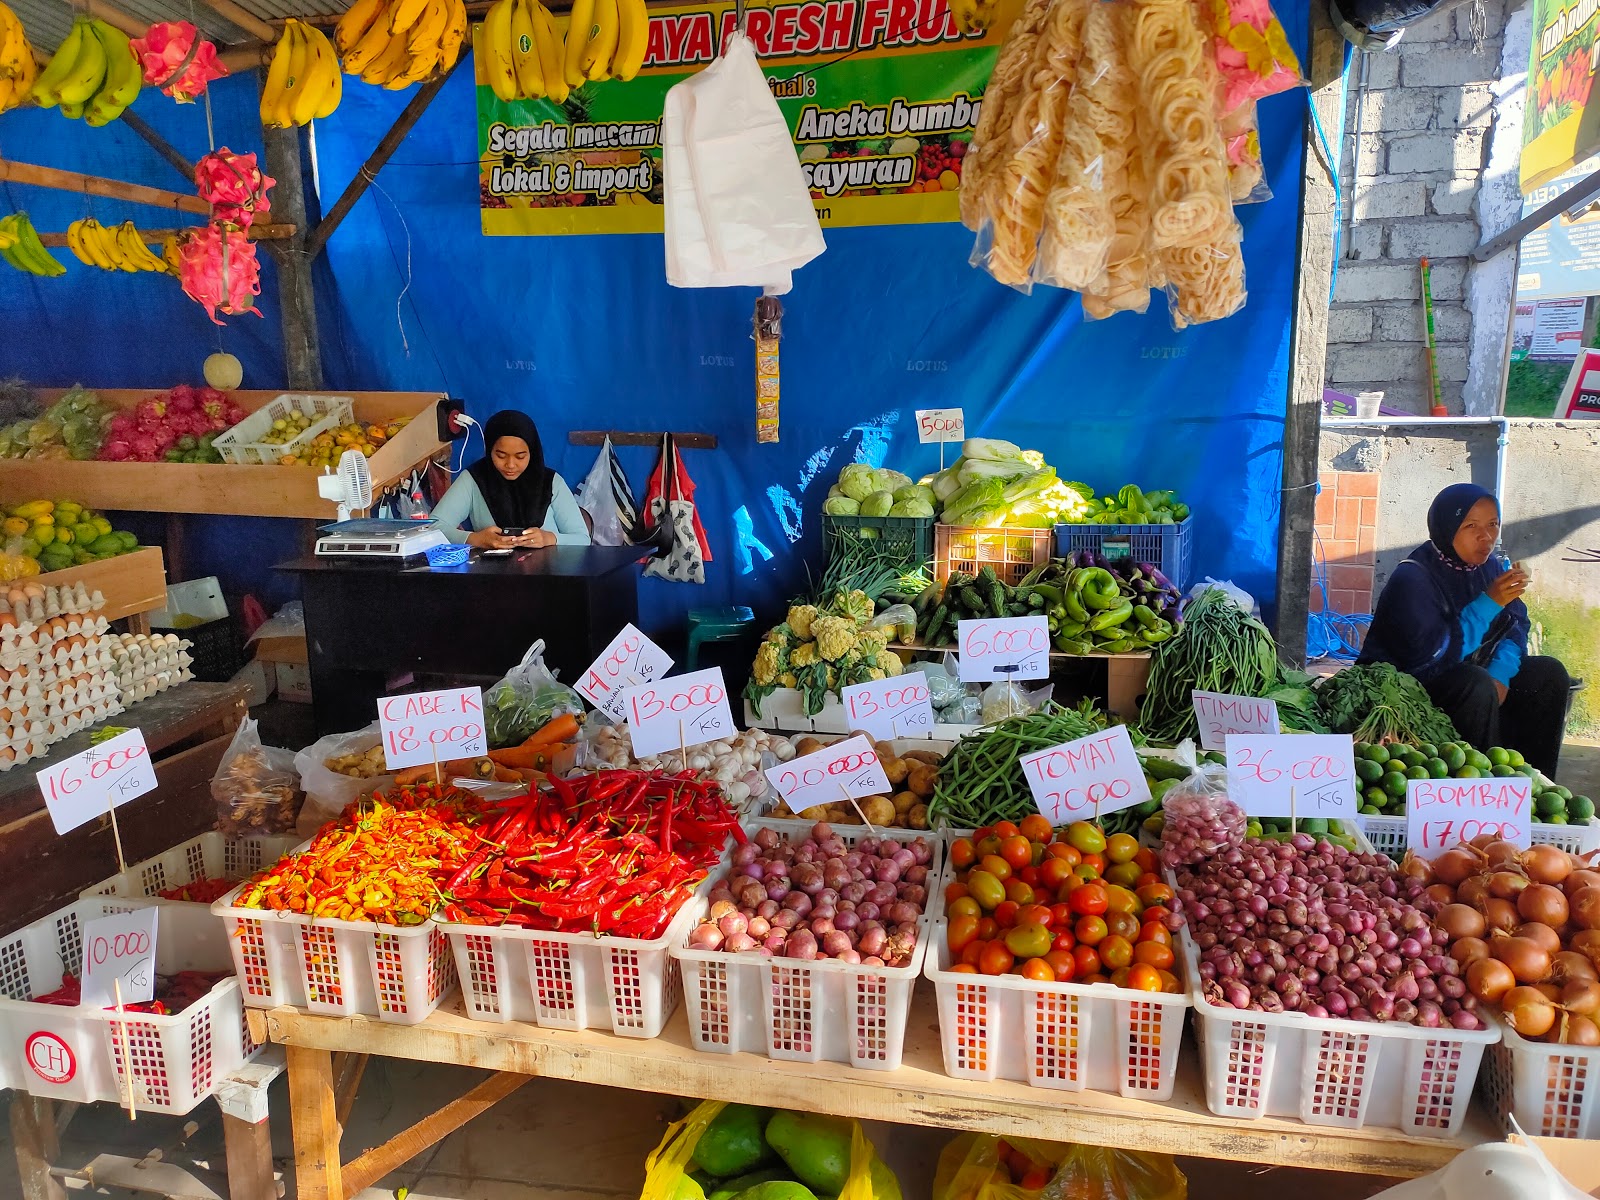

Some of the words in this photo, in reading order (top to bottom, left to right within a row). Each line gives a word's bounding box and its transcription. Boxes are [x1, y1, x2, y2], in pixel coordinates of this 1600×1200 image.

[643, 14, 714, 64] AYA
[858, 0, 983, 47] FRUI
[797, 104, 886, 140] Aneka
[490, 122, 567, 158] Segala
[574, 123, 656, 148] macam
[492, 165, 551, 192] lokal
[555, 165, 571, 190] &
[574, 161, 650, 196] import
[802, 156, 912, 195] sayuran
[505, 359, 537, 371] LOTUS
[700, 355, 735, 367] LOTUS
[906, 360, 949, 372] LOTUS
[1140, 346, 1188, 359] LOTUS
[921, 416, 963, 437] 5000
[699, 716, 721, 735] KG
[904, 712, 928, 727] KG
[1194, 696, 1270, 727] TIMUN
[1025, 734, 1120, 783] TOMAT
[857, 777, 876, 789] KG
[1045, 778, 1131, 820] 7000
[1315, 790, 1344, 809] KG
[1414, 782, 1528, 816] BOMBAY
[32, 1041, 66, 1074] CH
